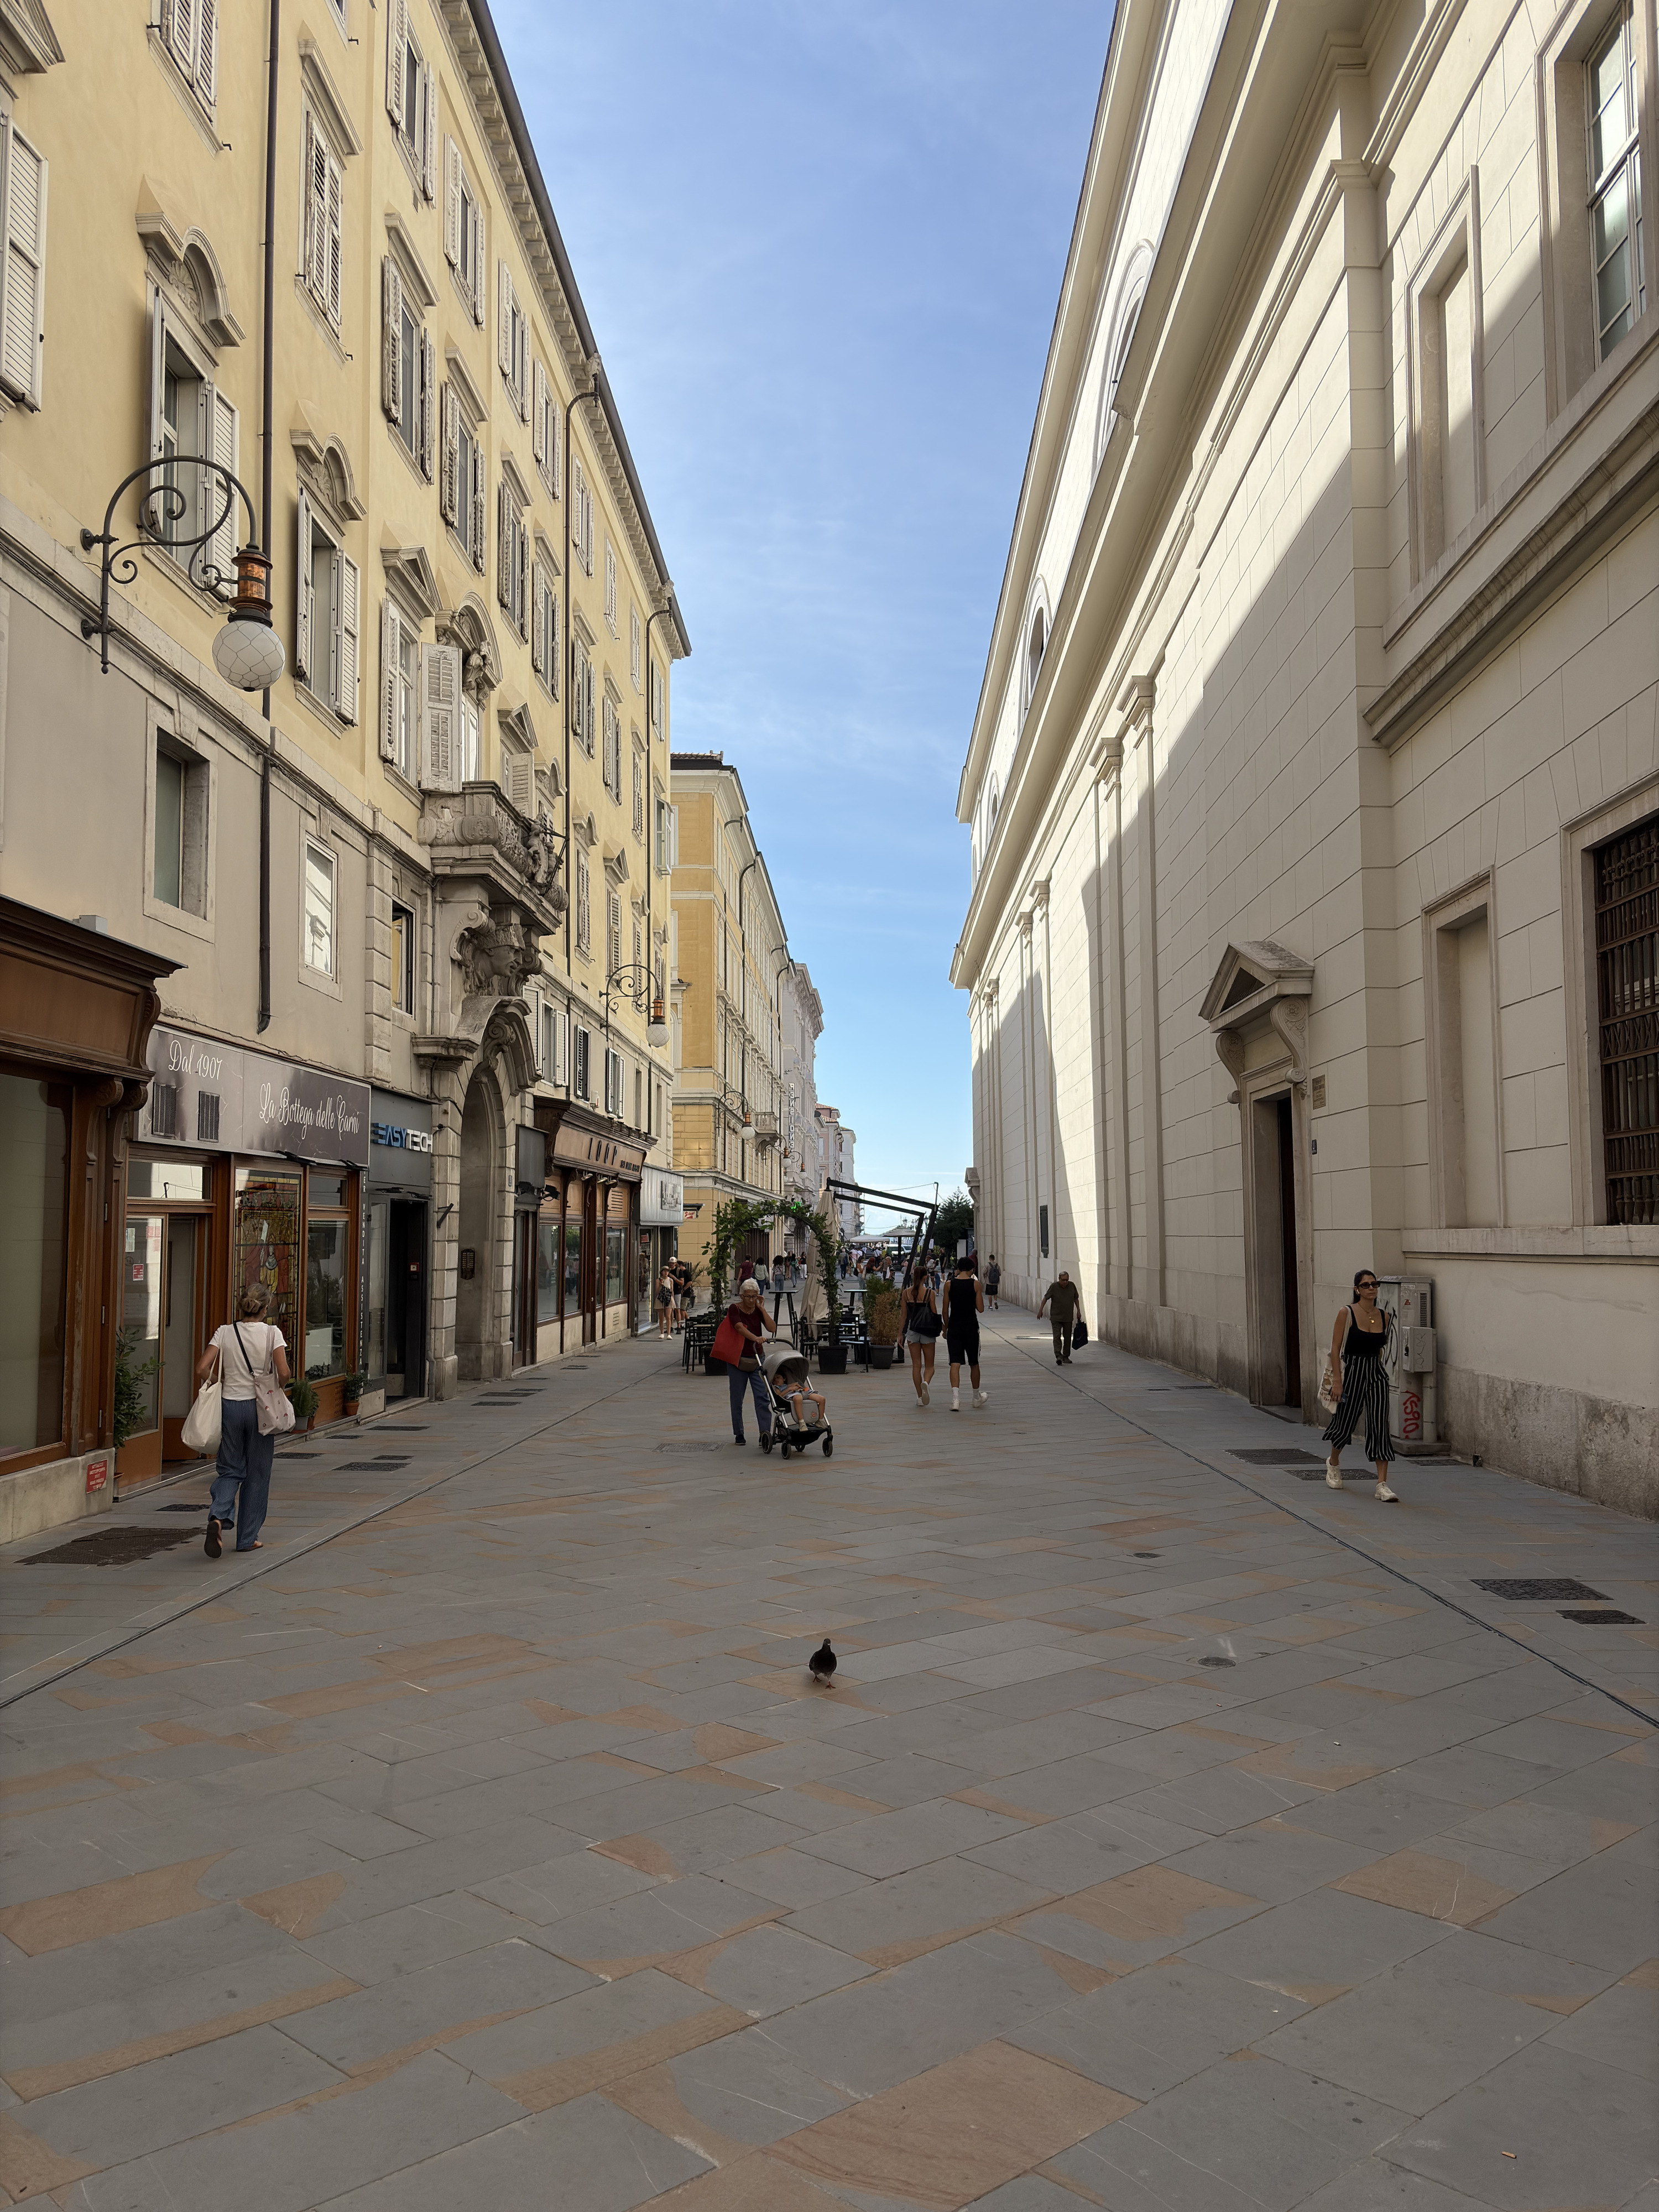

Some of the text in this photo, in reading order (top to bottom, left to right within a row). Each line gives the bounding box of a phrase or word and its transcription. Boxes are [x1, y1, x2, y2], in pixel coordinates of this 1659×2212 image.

[168, 1040, 222, 1080] Dal 1907
[259, 1082, 359, 1141] La Bottega delle Carni
